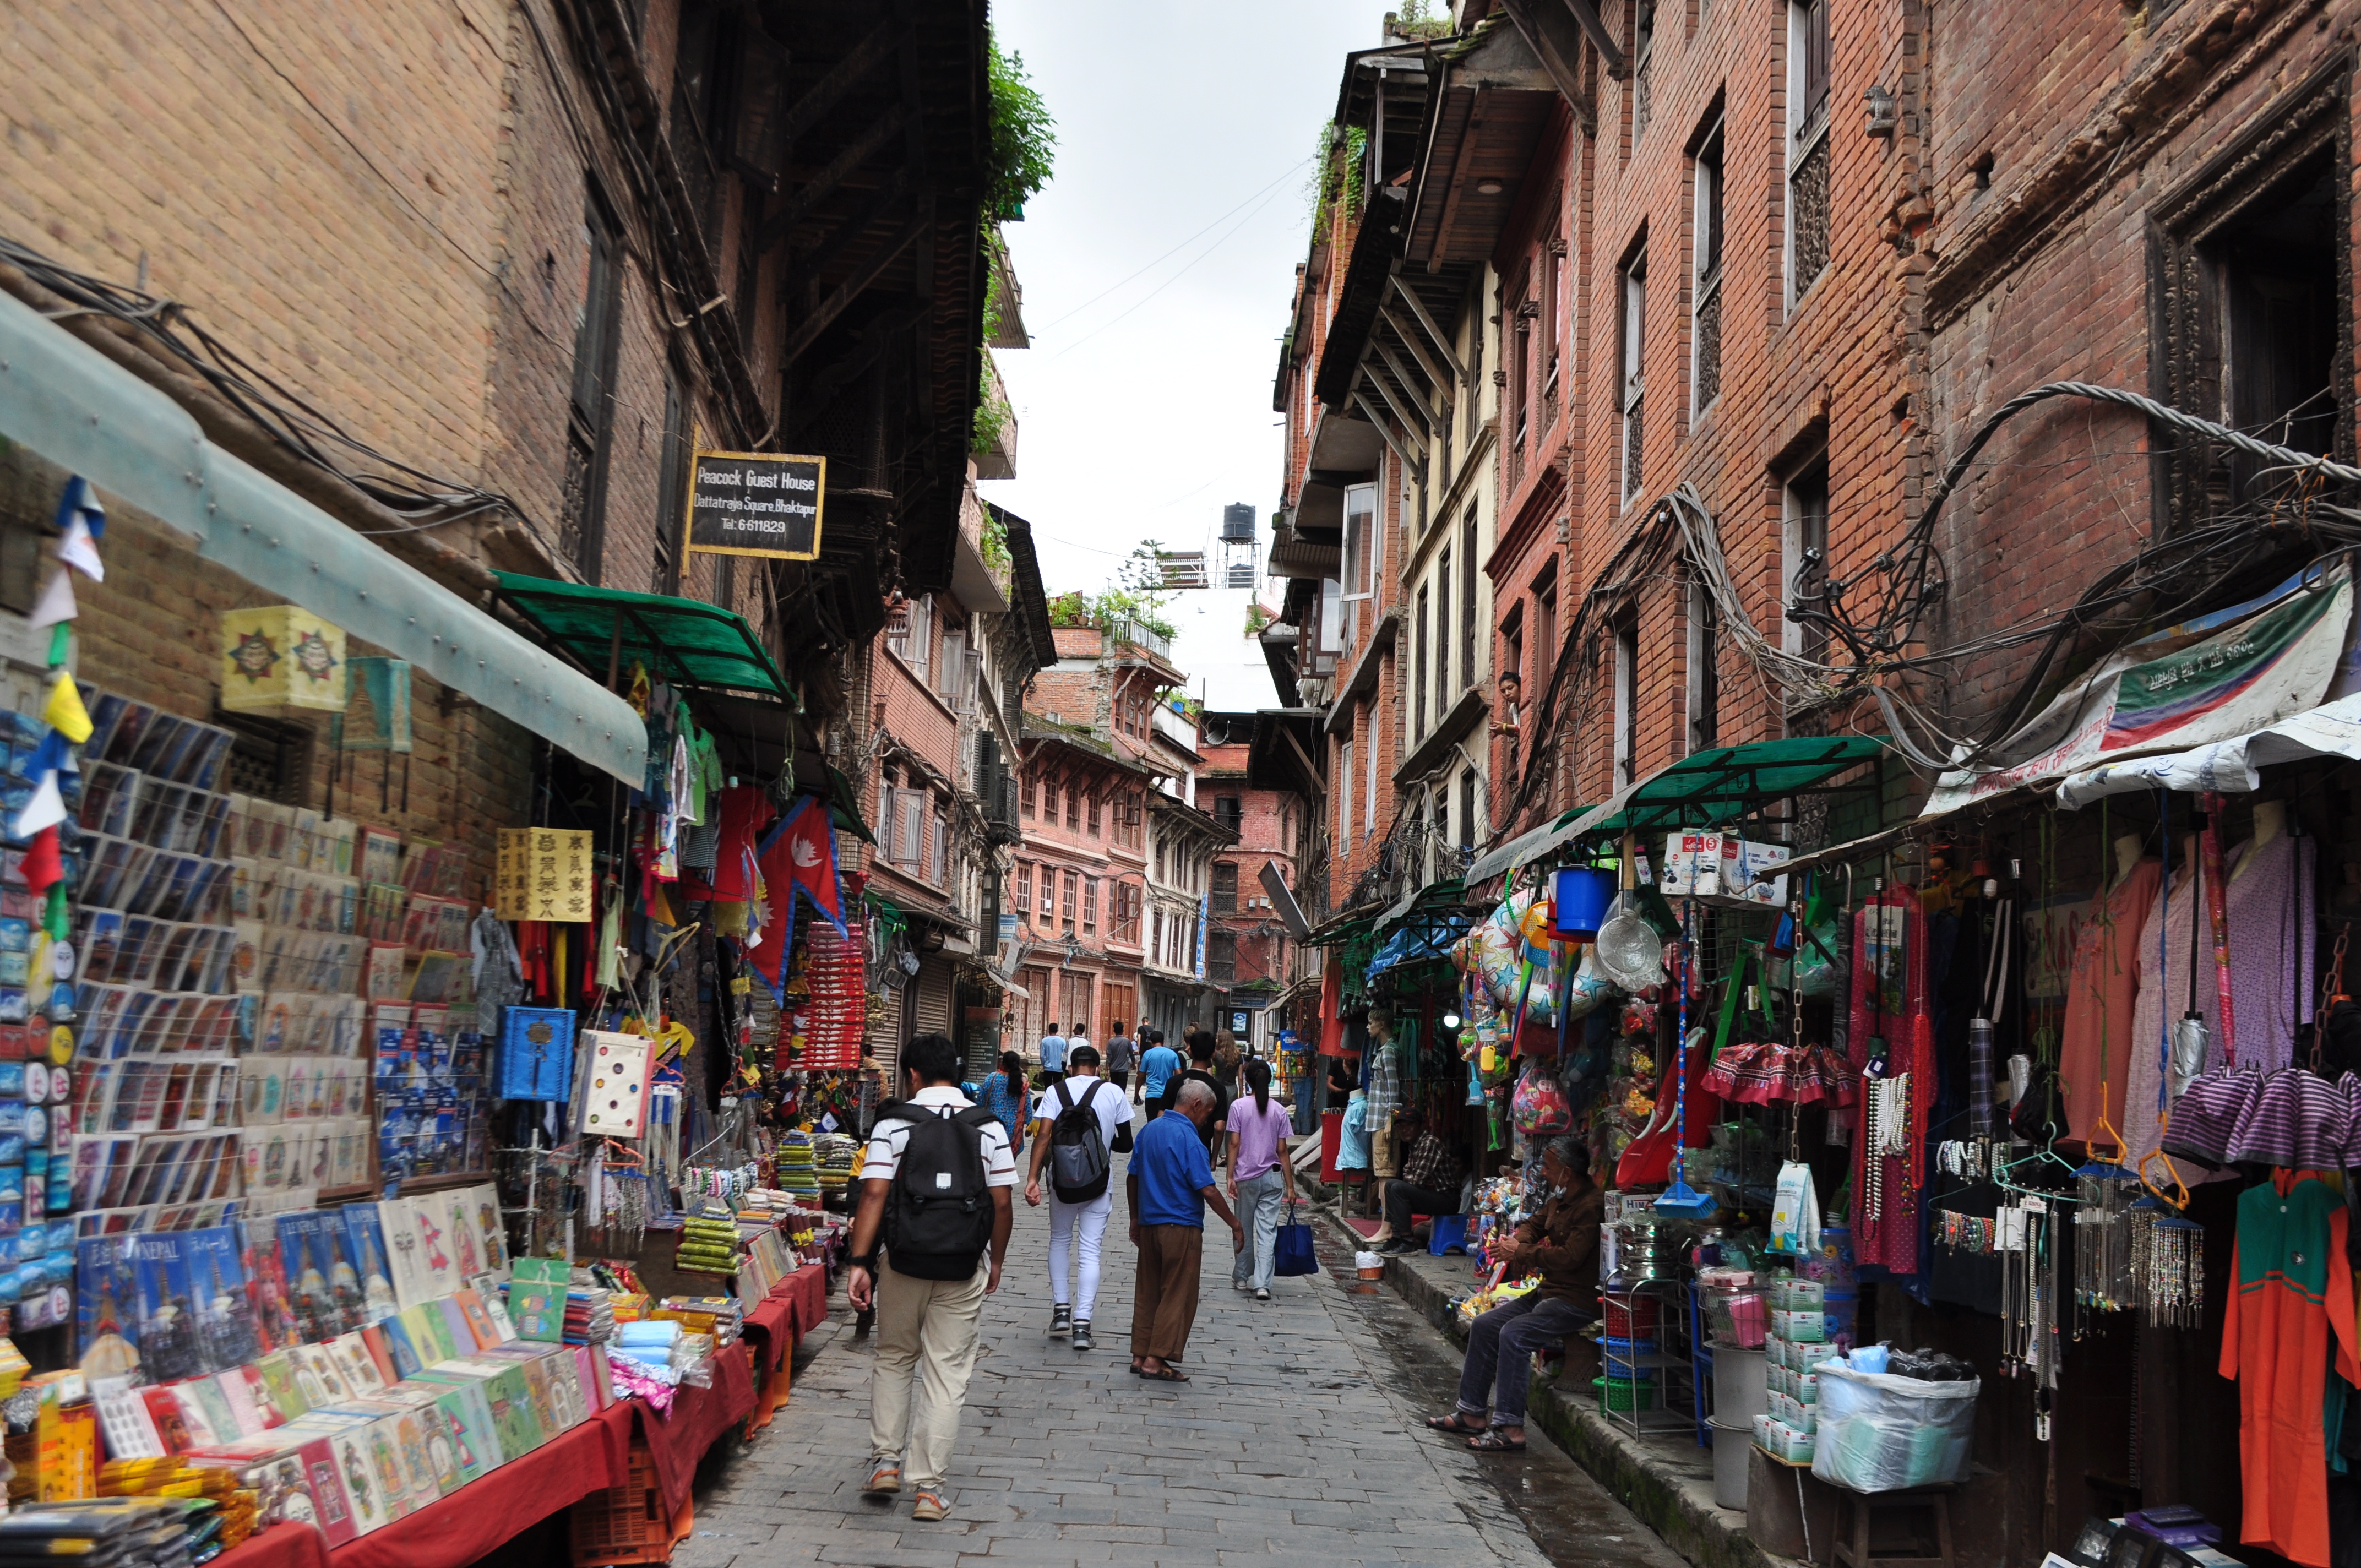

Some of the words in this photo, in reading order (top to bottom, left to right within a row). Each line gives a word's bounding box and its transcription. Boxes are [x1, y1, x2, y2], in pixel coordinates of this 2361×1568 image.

[697, 467, 741, 486] Peacock
[746, 470, 778, 488] Guest
[781, 472, 815, 491] House
[694, 493, 743, 512] Dattatraya
[1708, 839, 1715, 847] 5
